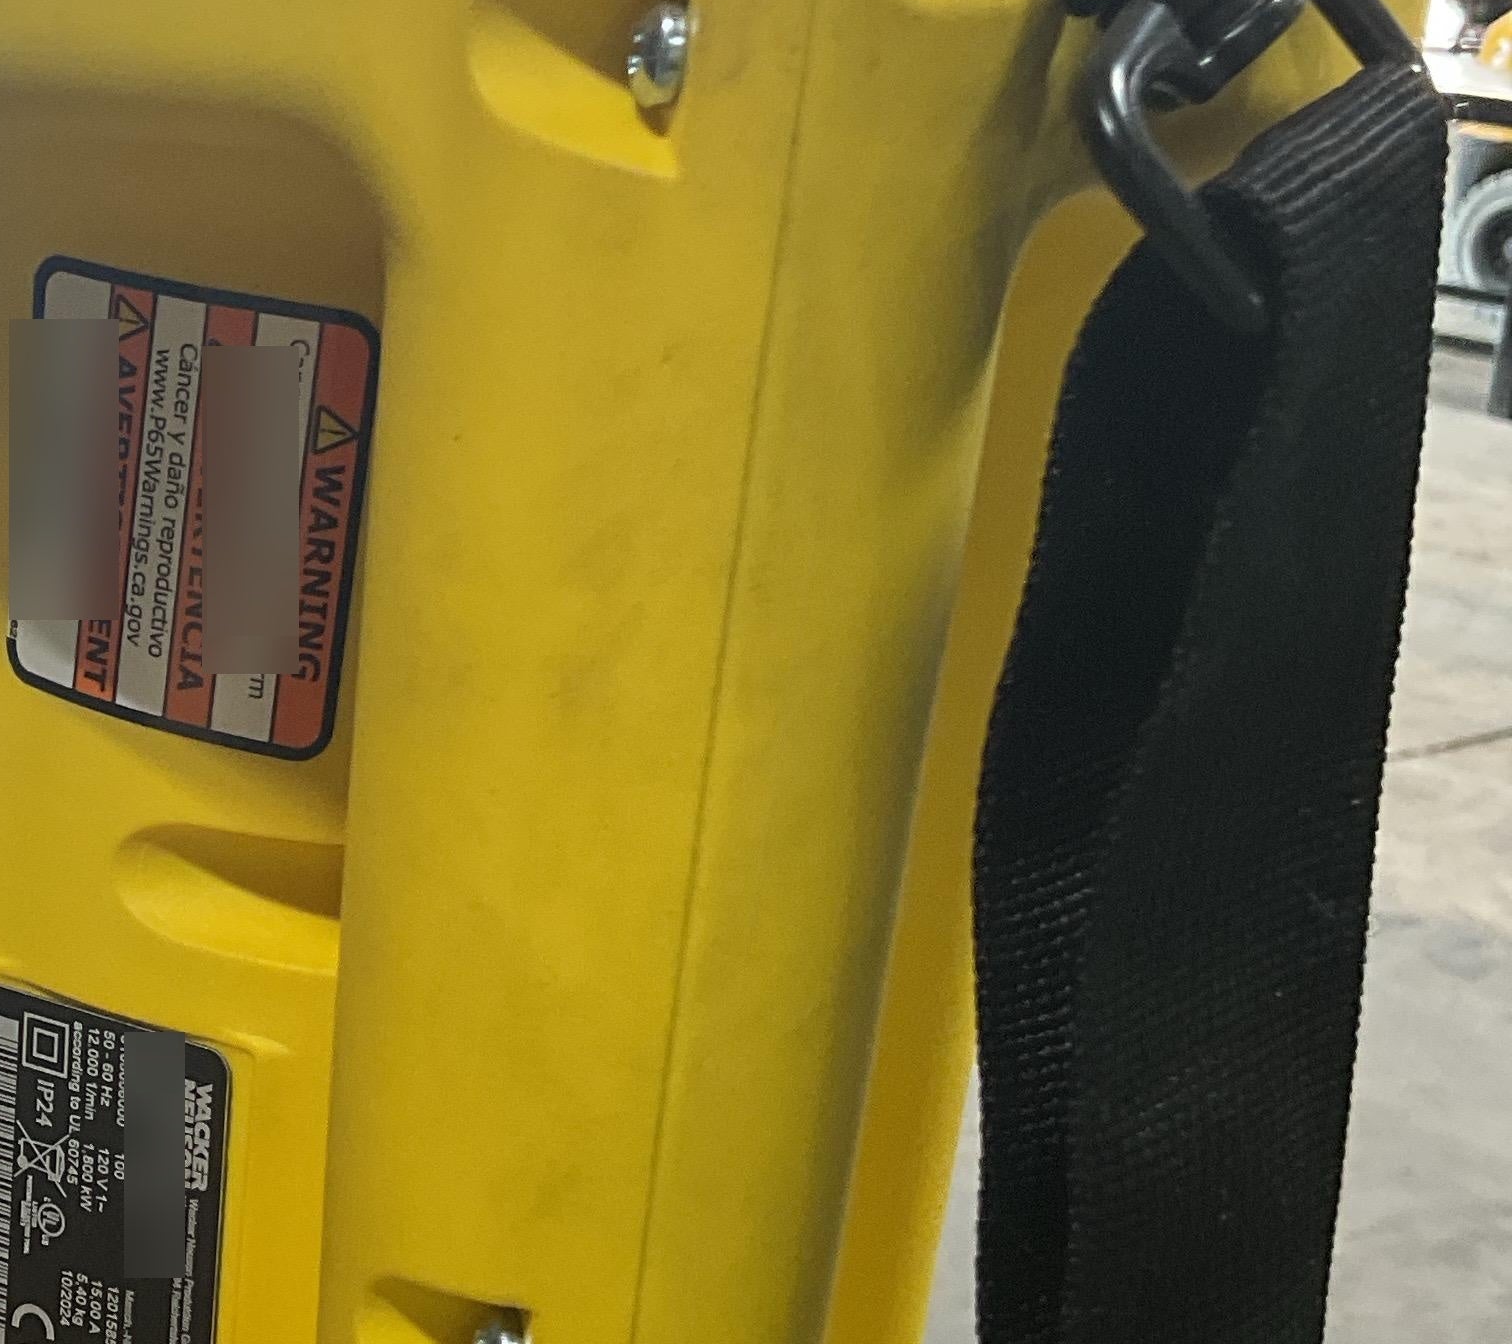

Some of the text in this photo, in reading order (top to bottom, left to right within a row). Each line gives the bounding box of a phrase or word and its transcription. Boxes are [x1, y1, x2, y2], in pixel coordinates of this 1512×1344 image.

[124, 349, 171, 648] www.P65Warnings.ca.gov
[148, 342, 200, 660] Cáncer y daño reproductivo
[291, 463, 346, 683] WARNING
[102, 1030, 116, 1051] 50
[100, 1062, 114, 1083] 60
[35, 1078, 55, 1129] IP24
[66, 1020, 84, 1187] according to UL 60745
[85, 1082, 98, 1121] 1/min
[99, 1085, 113, 1107] Hz
[190, 1083, 214, 1192] WACKER
[98, 1148, 110, 1175] 120
[80, 1184, 93, 1213] kW
[96, 1179, 107, 1192] V
[59, 1269, 73, 1327] 10/2024
[71, 1308, 86, 1328] kg
[88, 1322, 100, 1335] A
